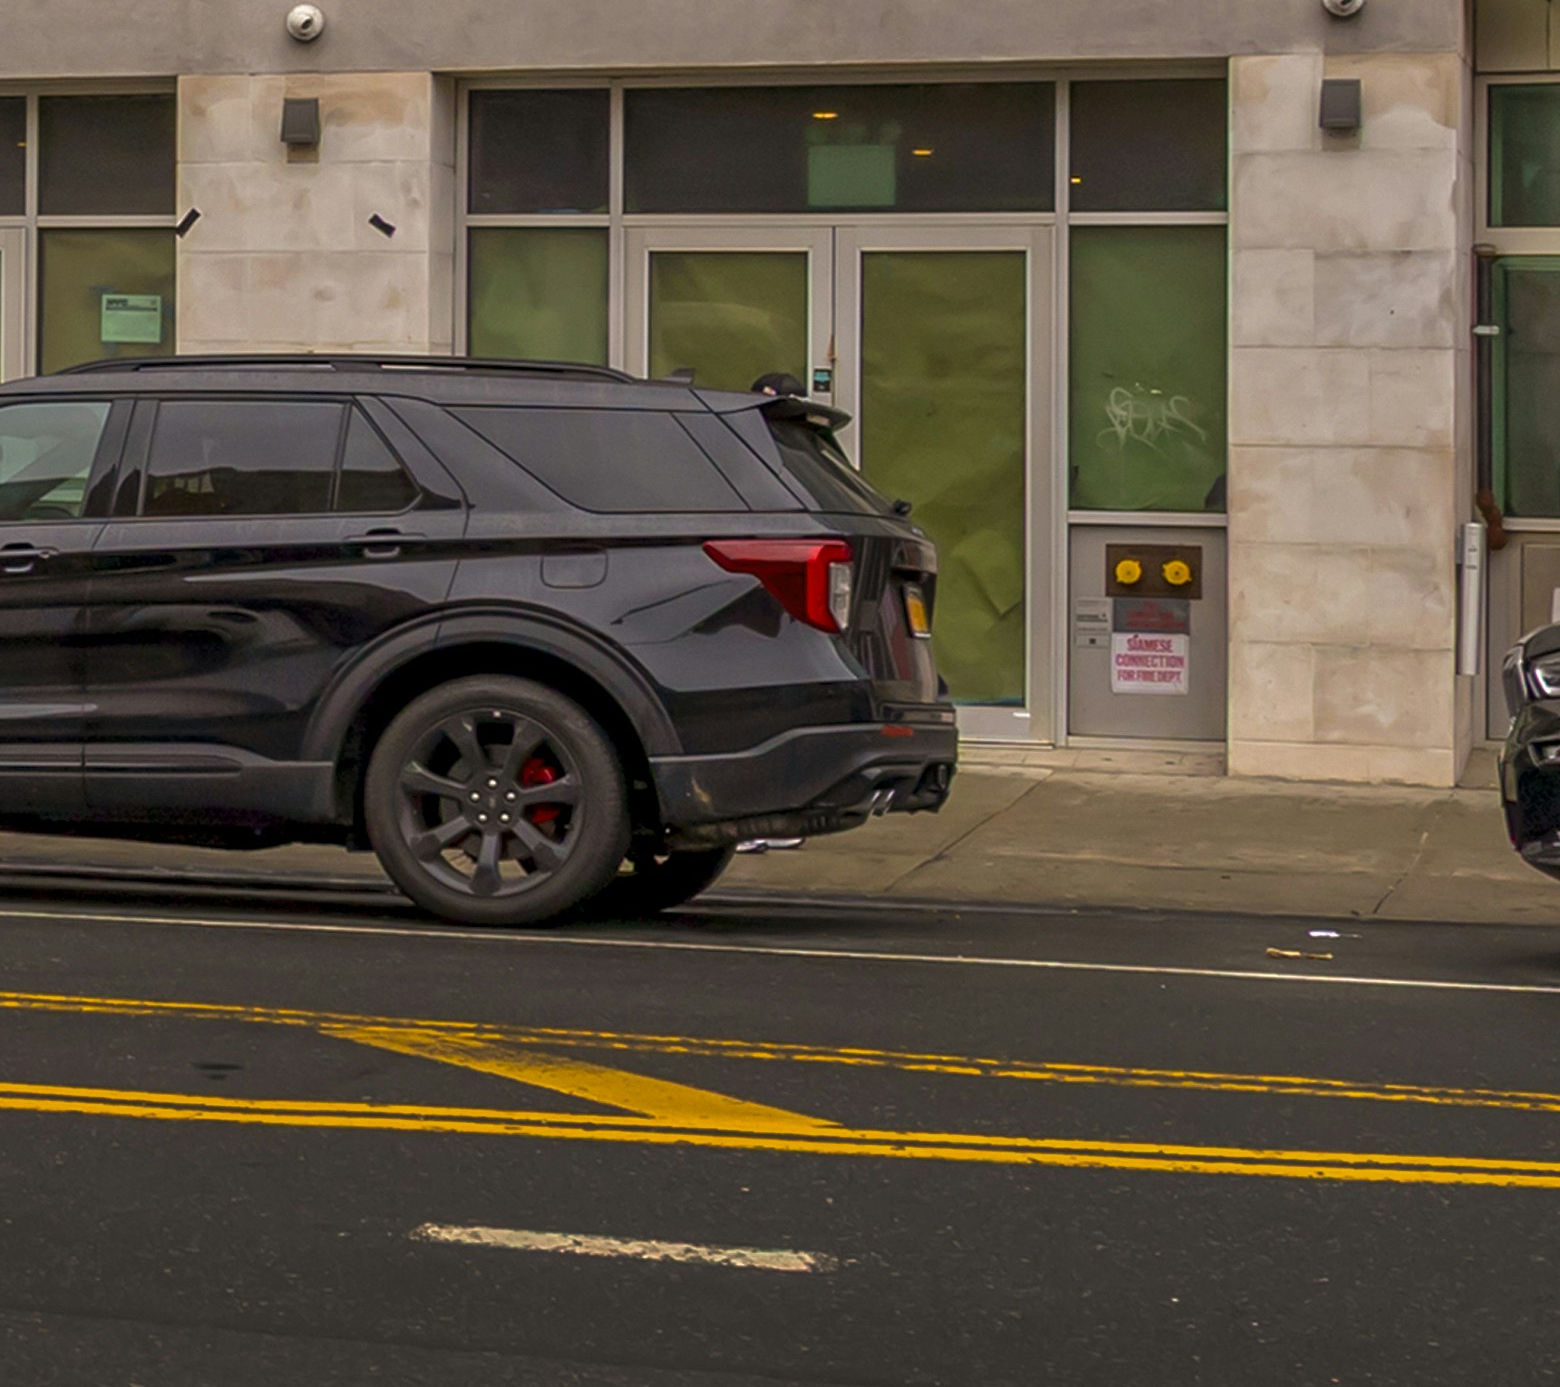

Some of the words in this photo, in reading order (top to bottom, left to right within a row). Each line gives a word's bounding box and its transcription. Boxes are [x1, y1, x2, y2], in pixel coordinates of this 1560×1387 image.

[1127, 638, 1173, 653] SIAMESE
[1116, 654, 1184, 668] CONNECTION
[1118, 670, 1136, 681] FOR
